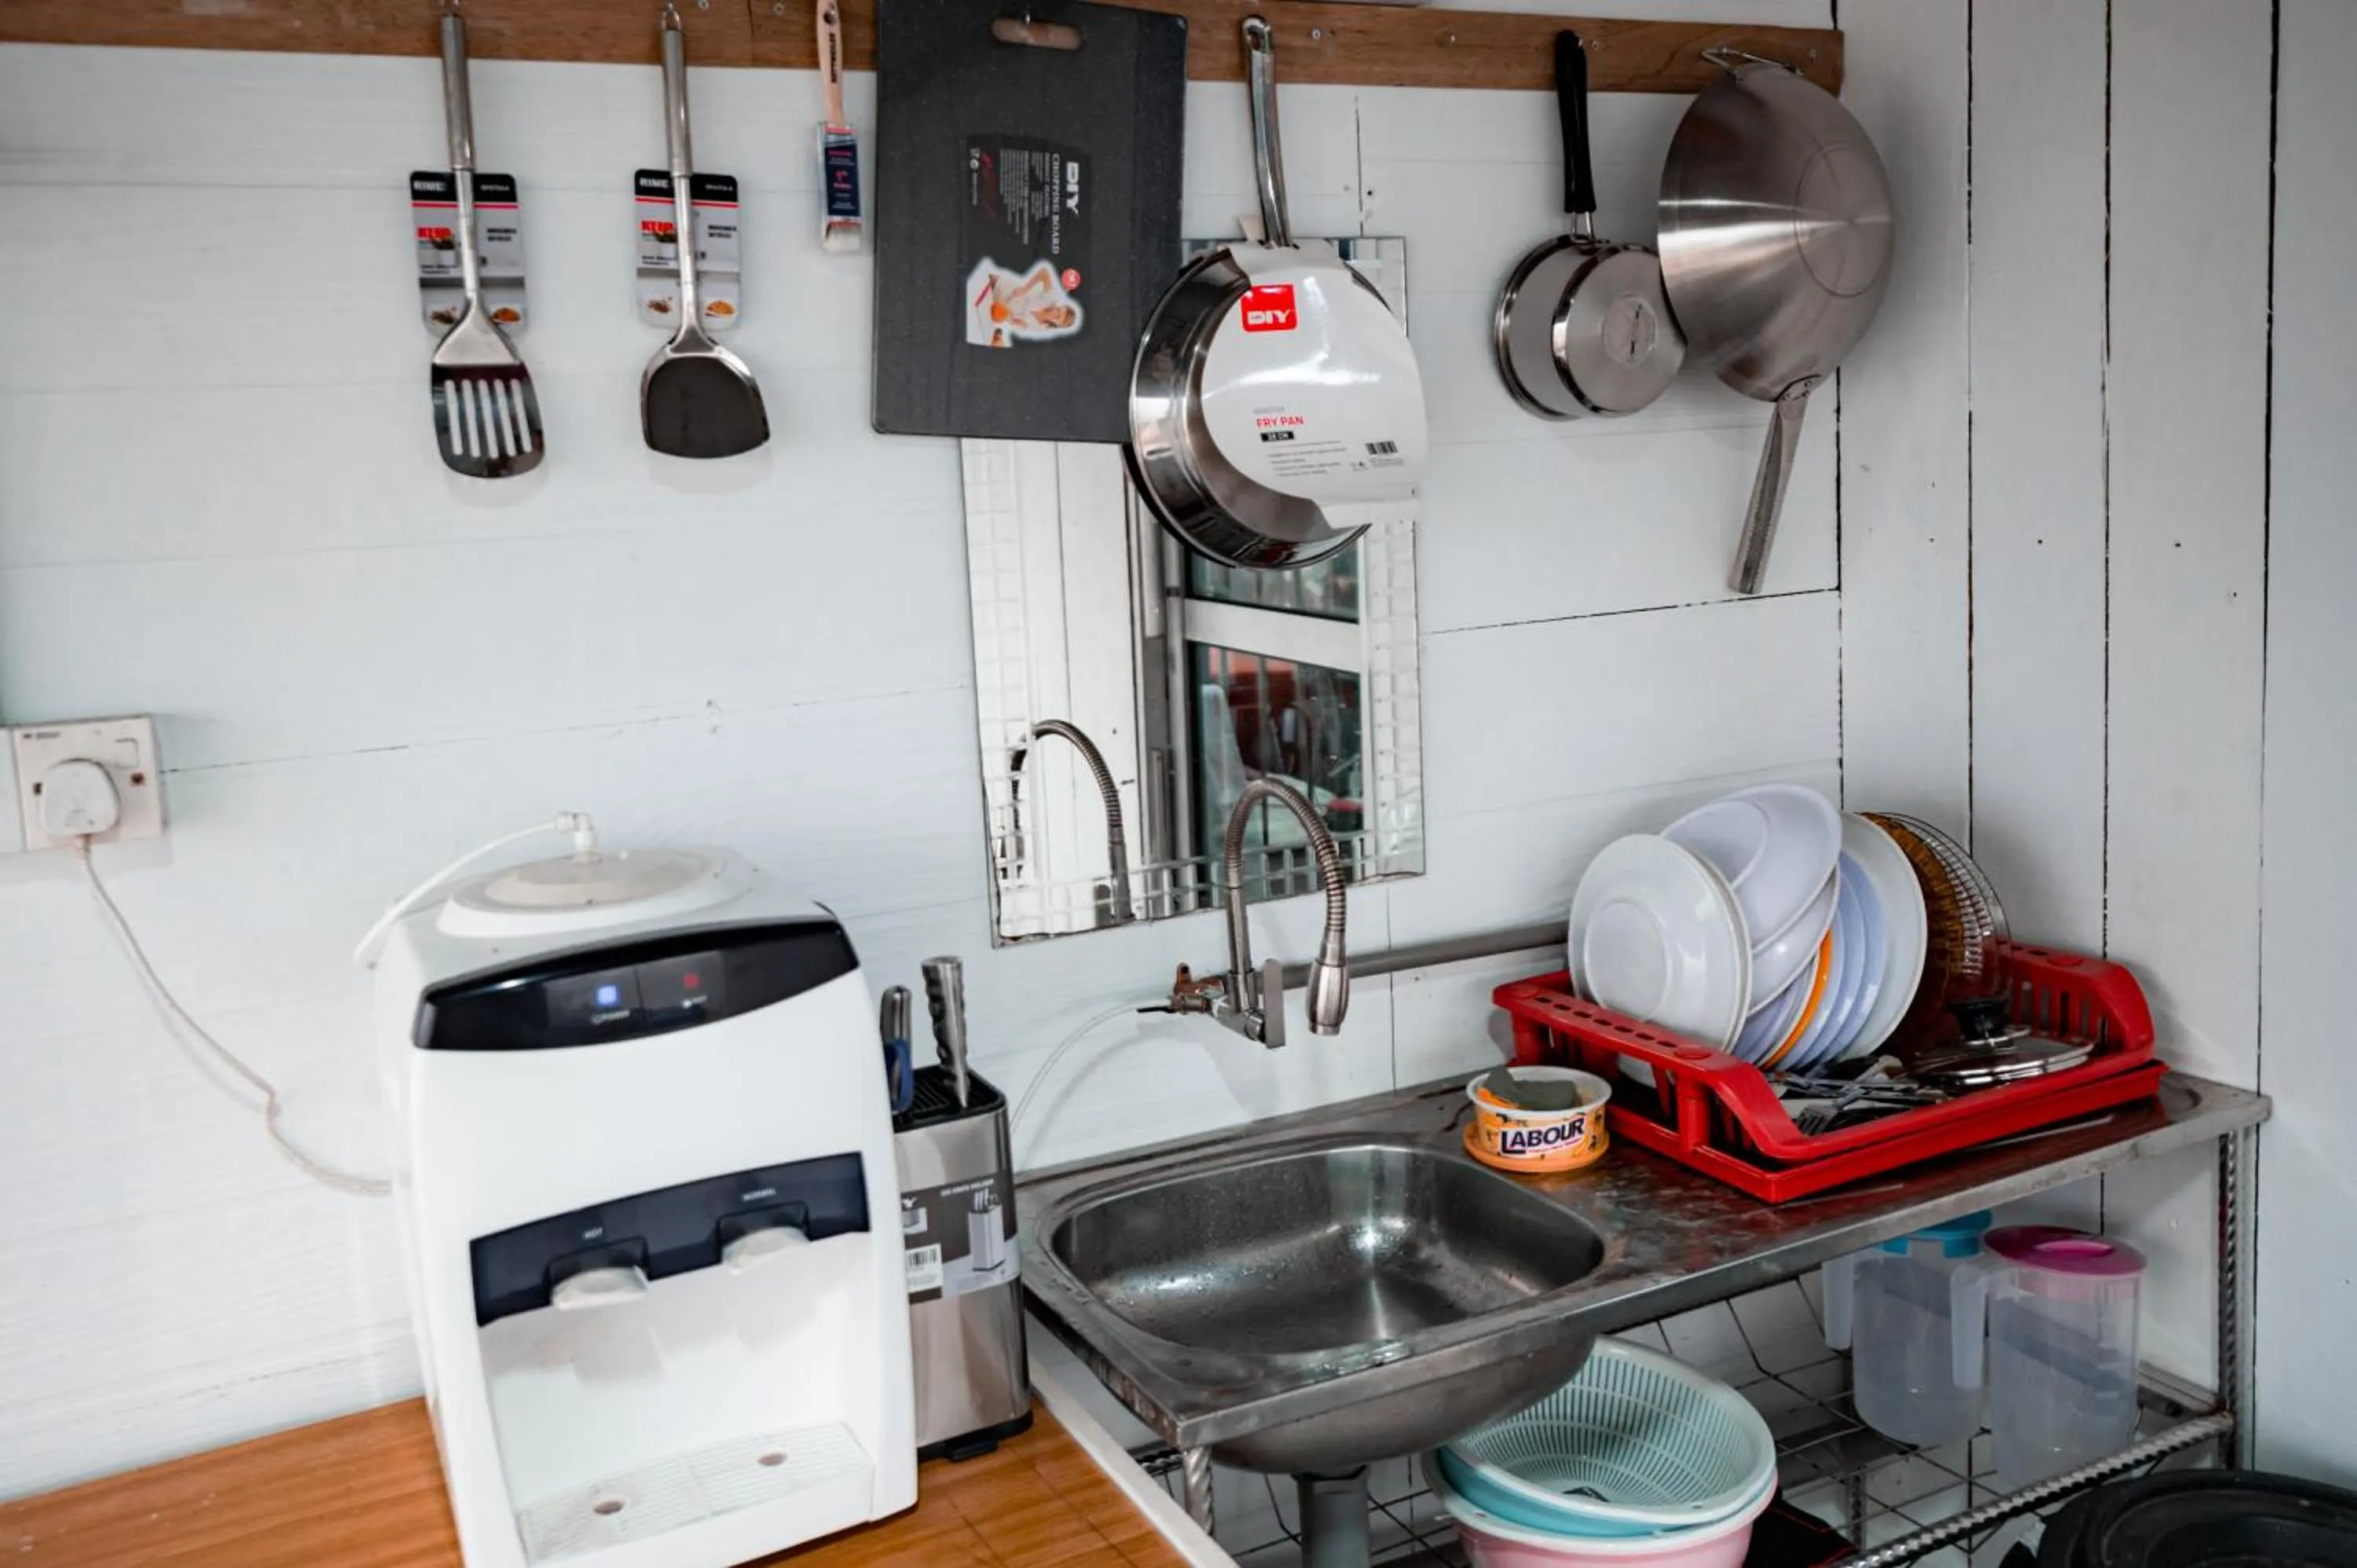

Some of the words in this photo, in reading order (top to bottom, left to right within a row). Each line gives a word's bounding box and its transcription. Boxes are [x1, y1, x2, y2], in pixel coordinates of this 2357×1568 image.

[1052, 152, 1061, 212] CHOPPING
[1052, 214, 1061, 255] BOARD
[1256, 418, 1277, 427] FRY
[1280, 416, 1304, 427] PAN
[1501, 1117, 1585, 1155] LABOUR
